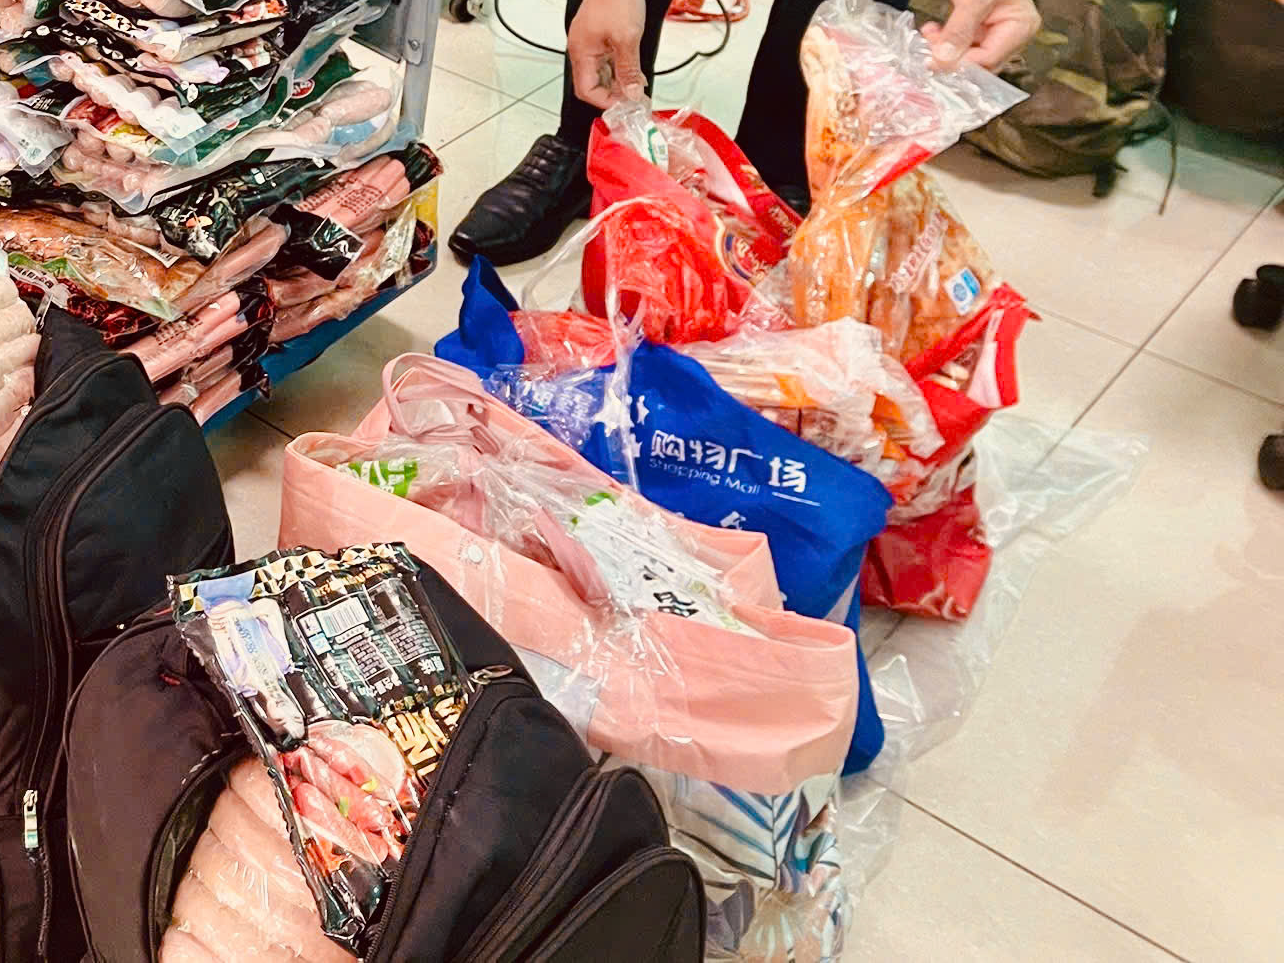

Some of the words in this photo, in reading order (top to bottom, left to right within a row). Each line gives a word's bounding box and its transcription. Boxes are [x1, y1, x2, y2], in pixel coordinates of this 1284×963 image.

[648, 457, 722, 486] Shopping
[724, 476, 762, 495] Mall
[650, 428, 808, 494] 购物广场
